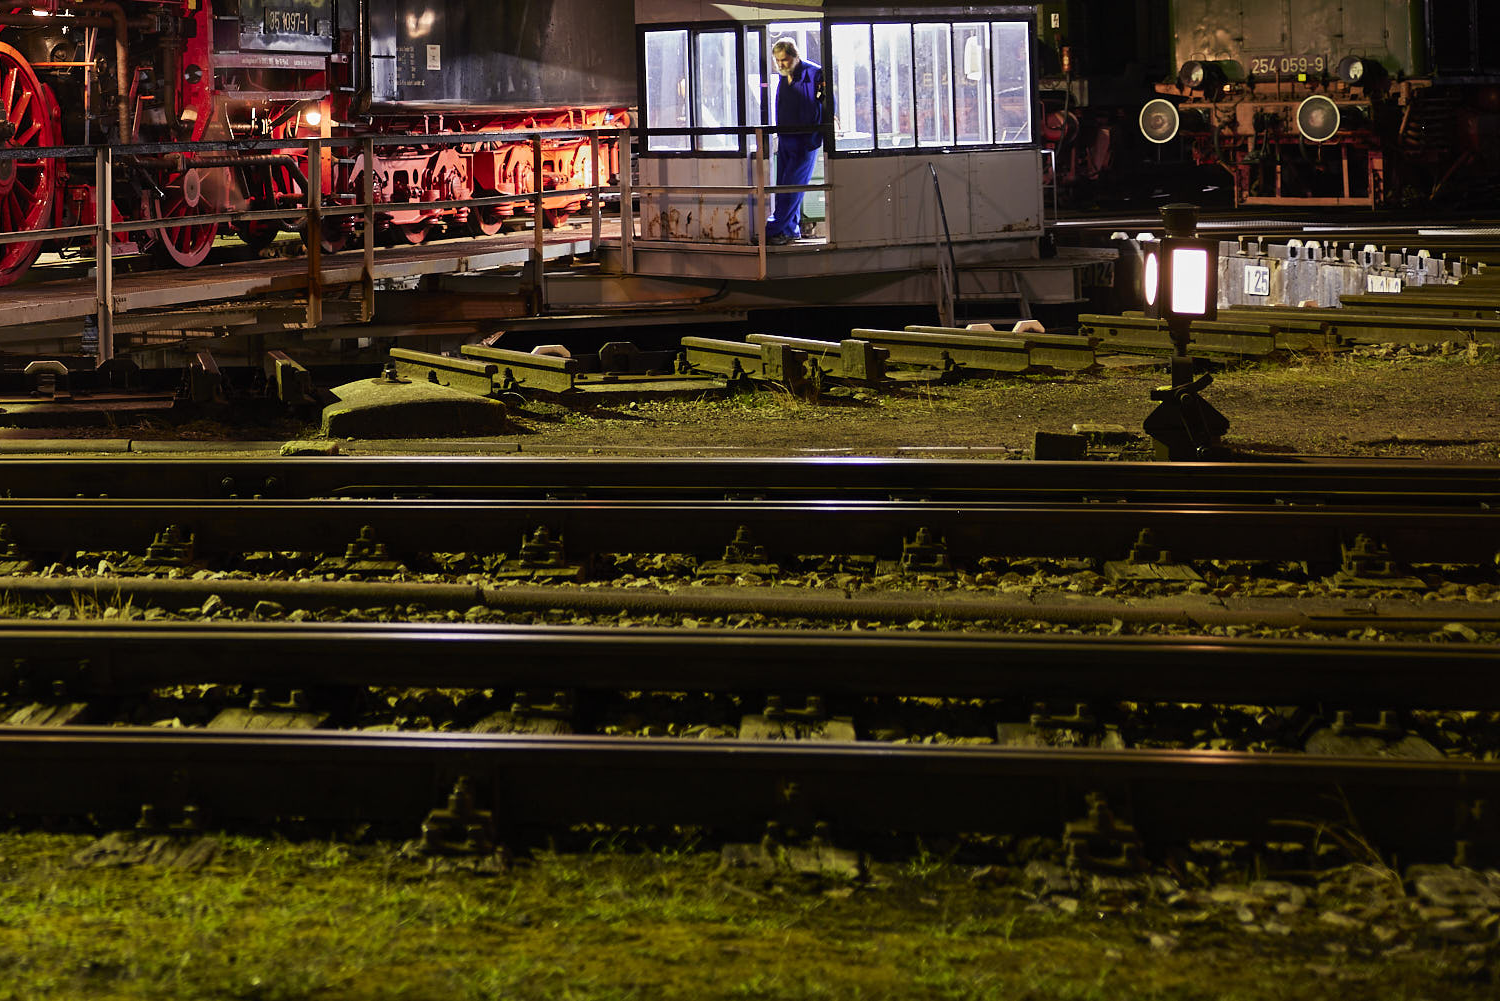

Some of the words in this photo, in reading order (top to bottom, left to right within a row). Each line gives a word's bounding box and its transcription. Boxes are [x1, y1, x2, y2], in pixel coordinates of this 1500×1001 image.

[1251, 58, 1277, 74] 254
[1280, 56, 1324, 74] 059-9
[1254, 270, 1268, 293] 25
